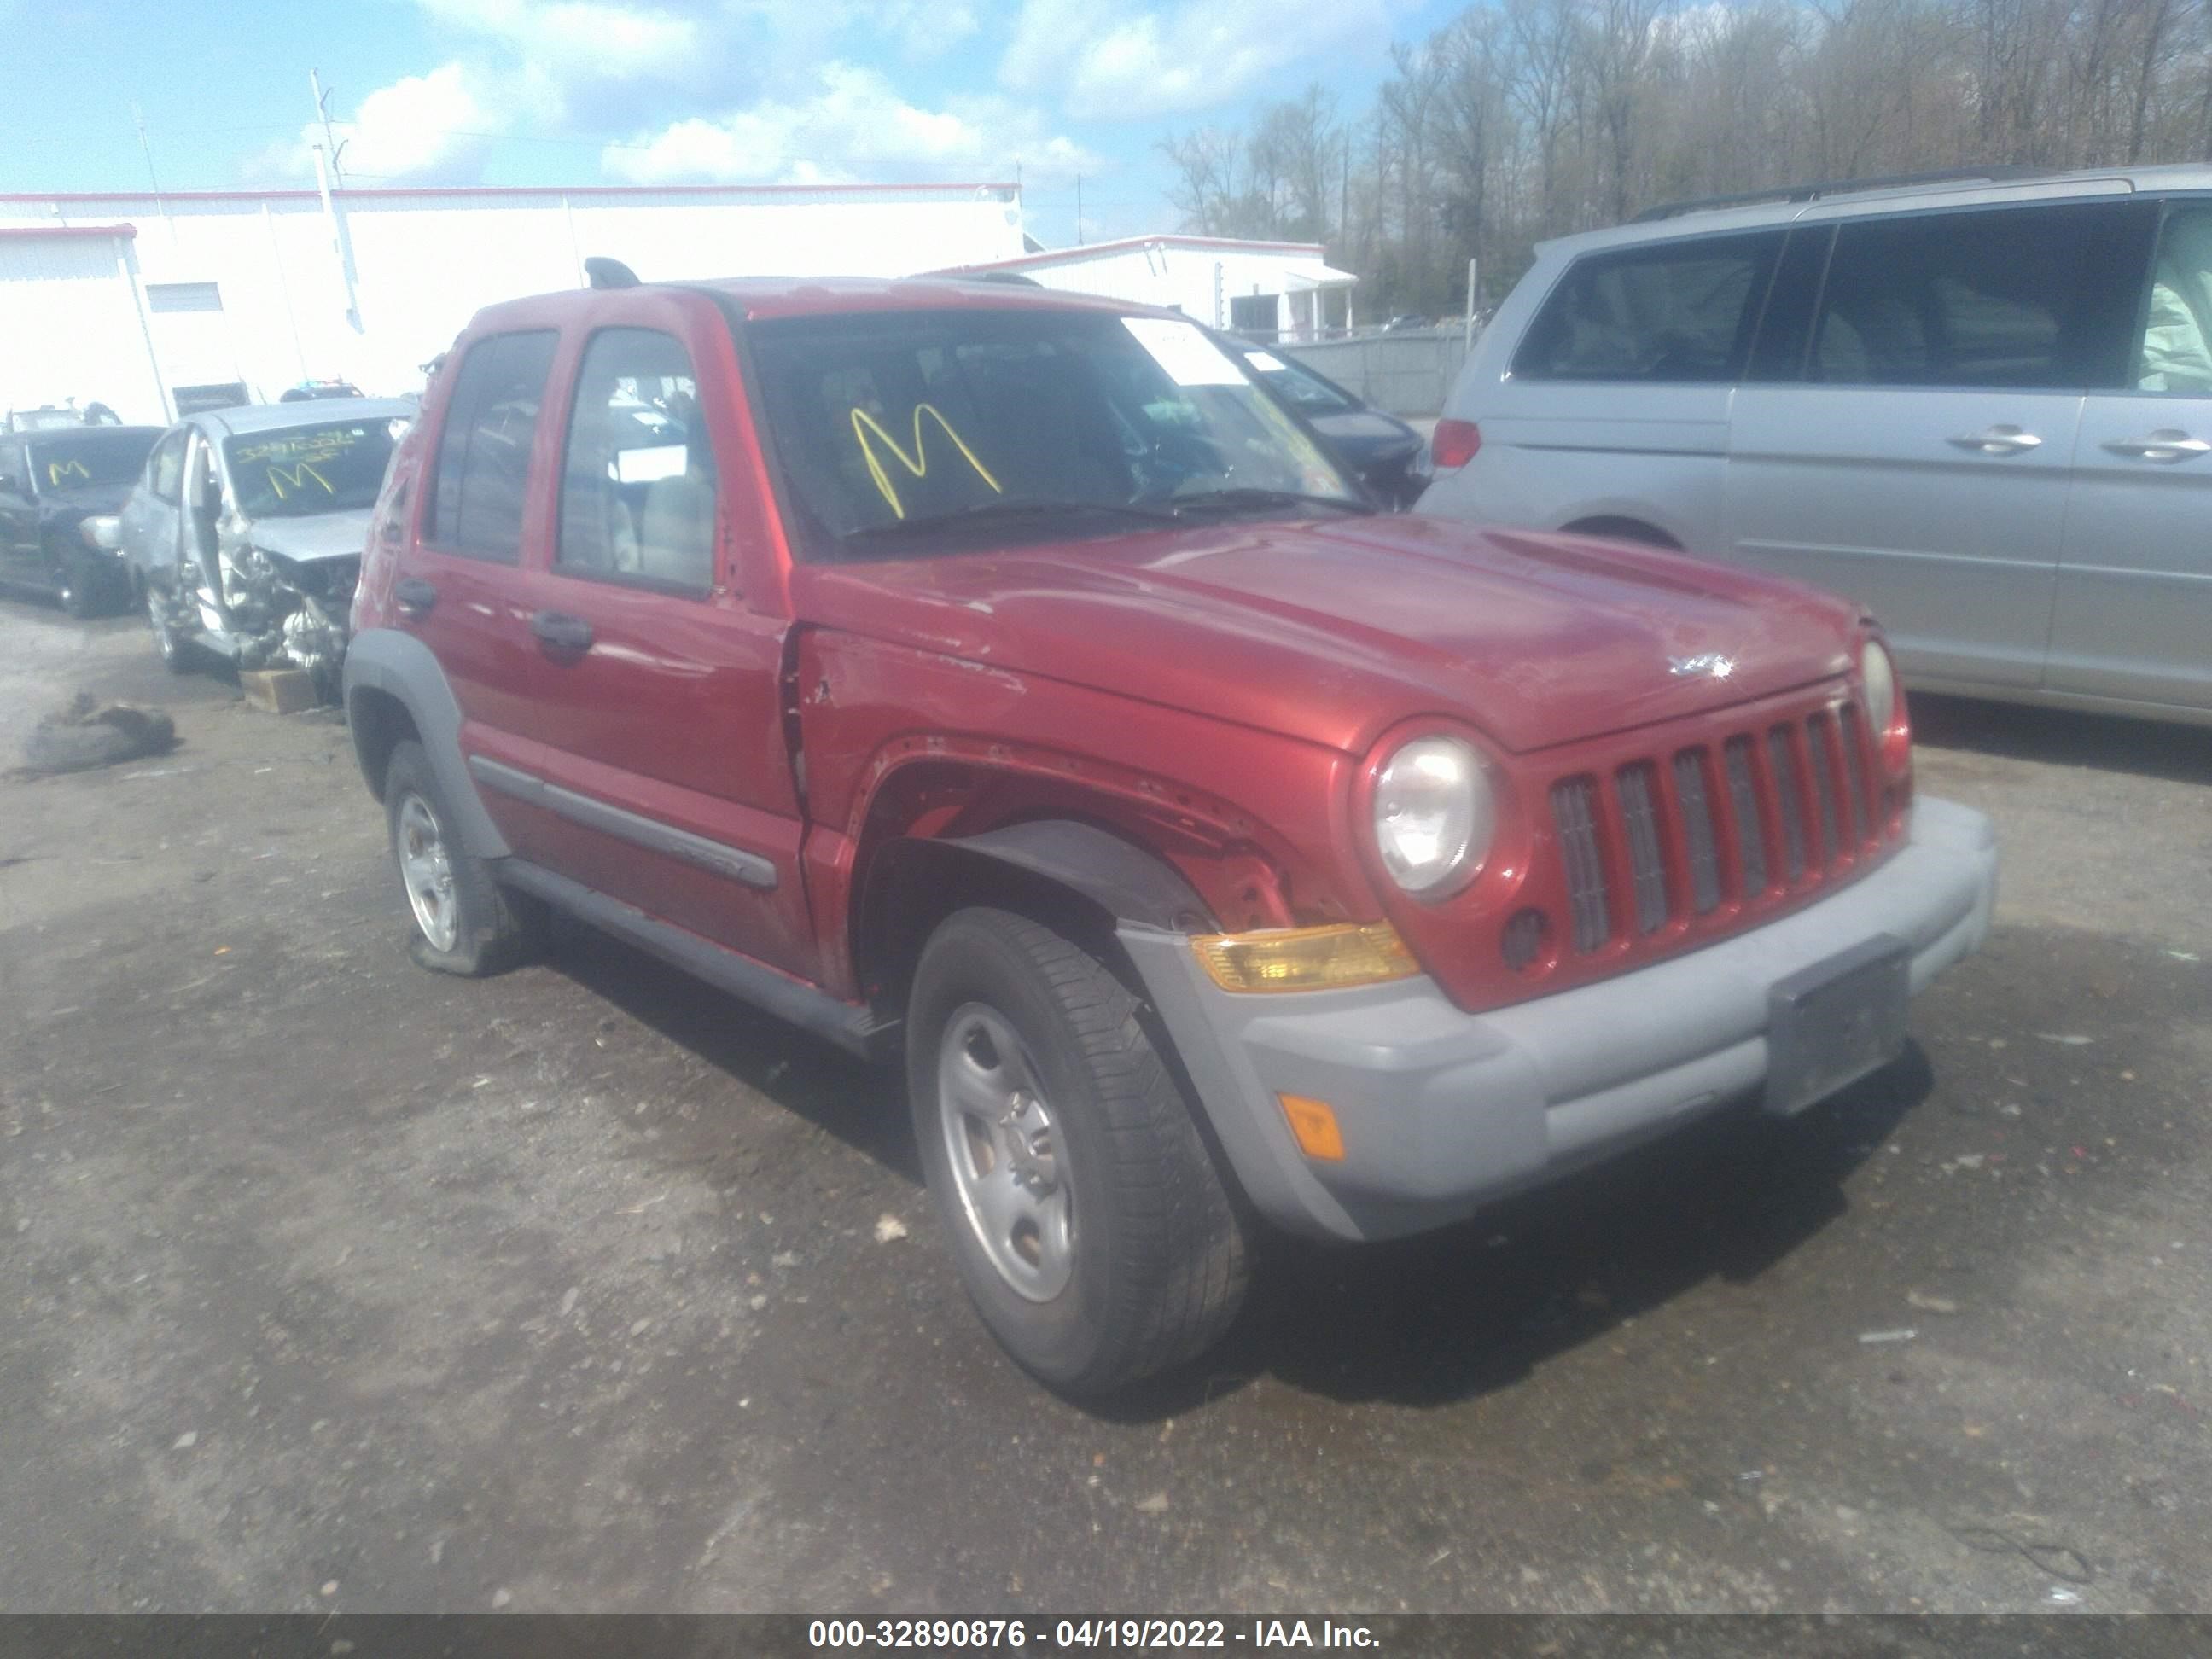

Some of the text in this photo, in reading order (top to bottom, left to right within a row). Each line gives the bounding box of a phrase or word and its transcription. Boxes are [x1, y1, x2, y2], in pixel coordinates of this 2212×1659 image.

[49, 461, 90, 486] M
[851, 403, 1003, 519] M
[266, 463, 335, 499] M
